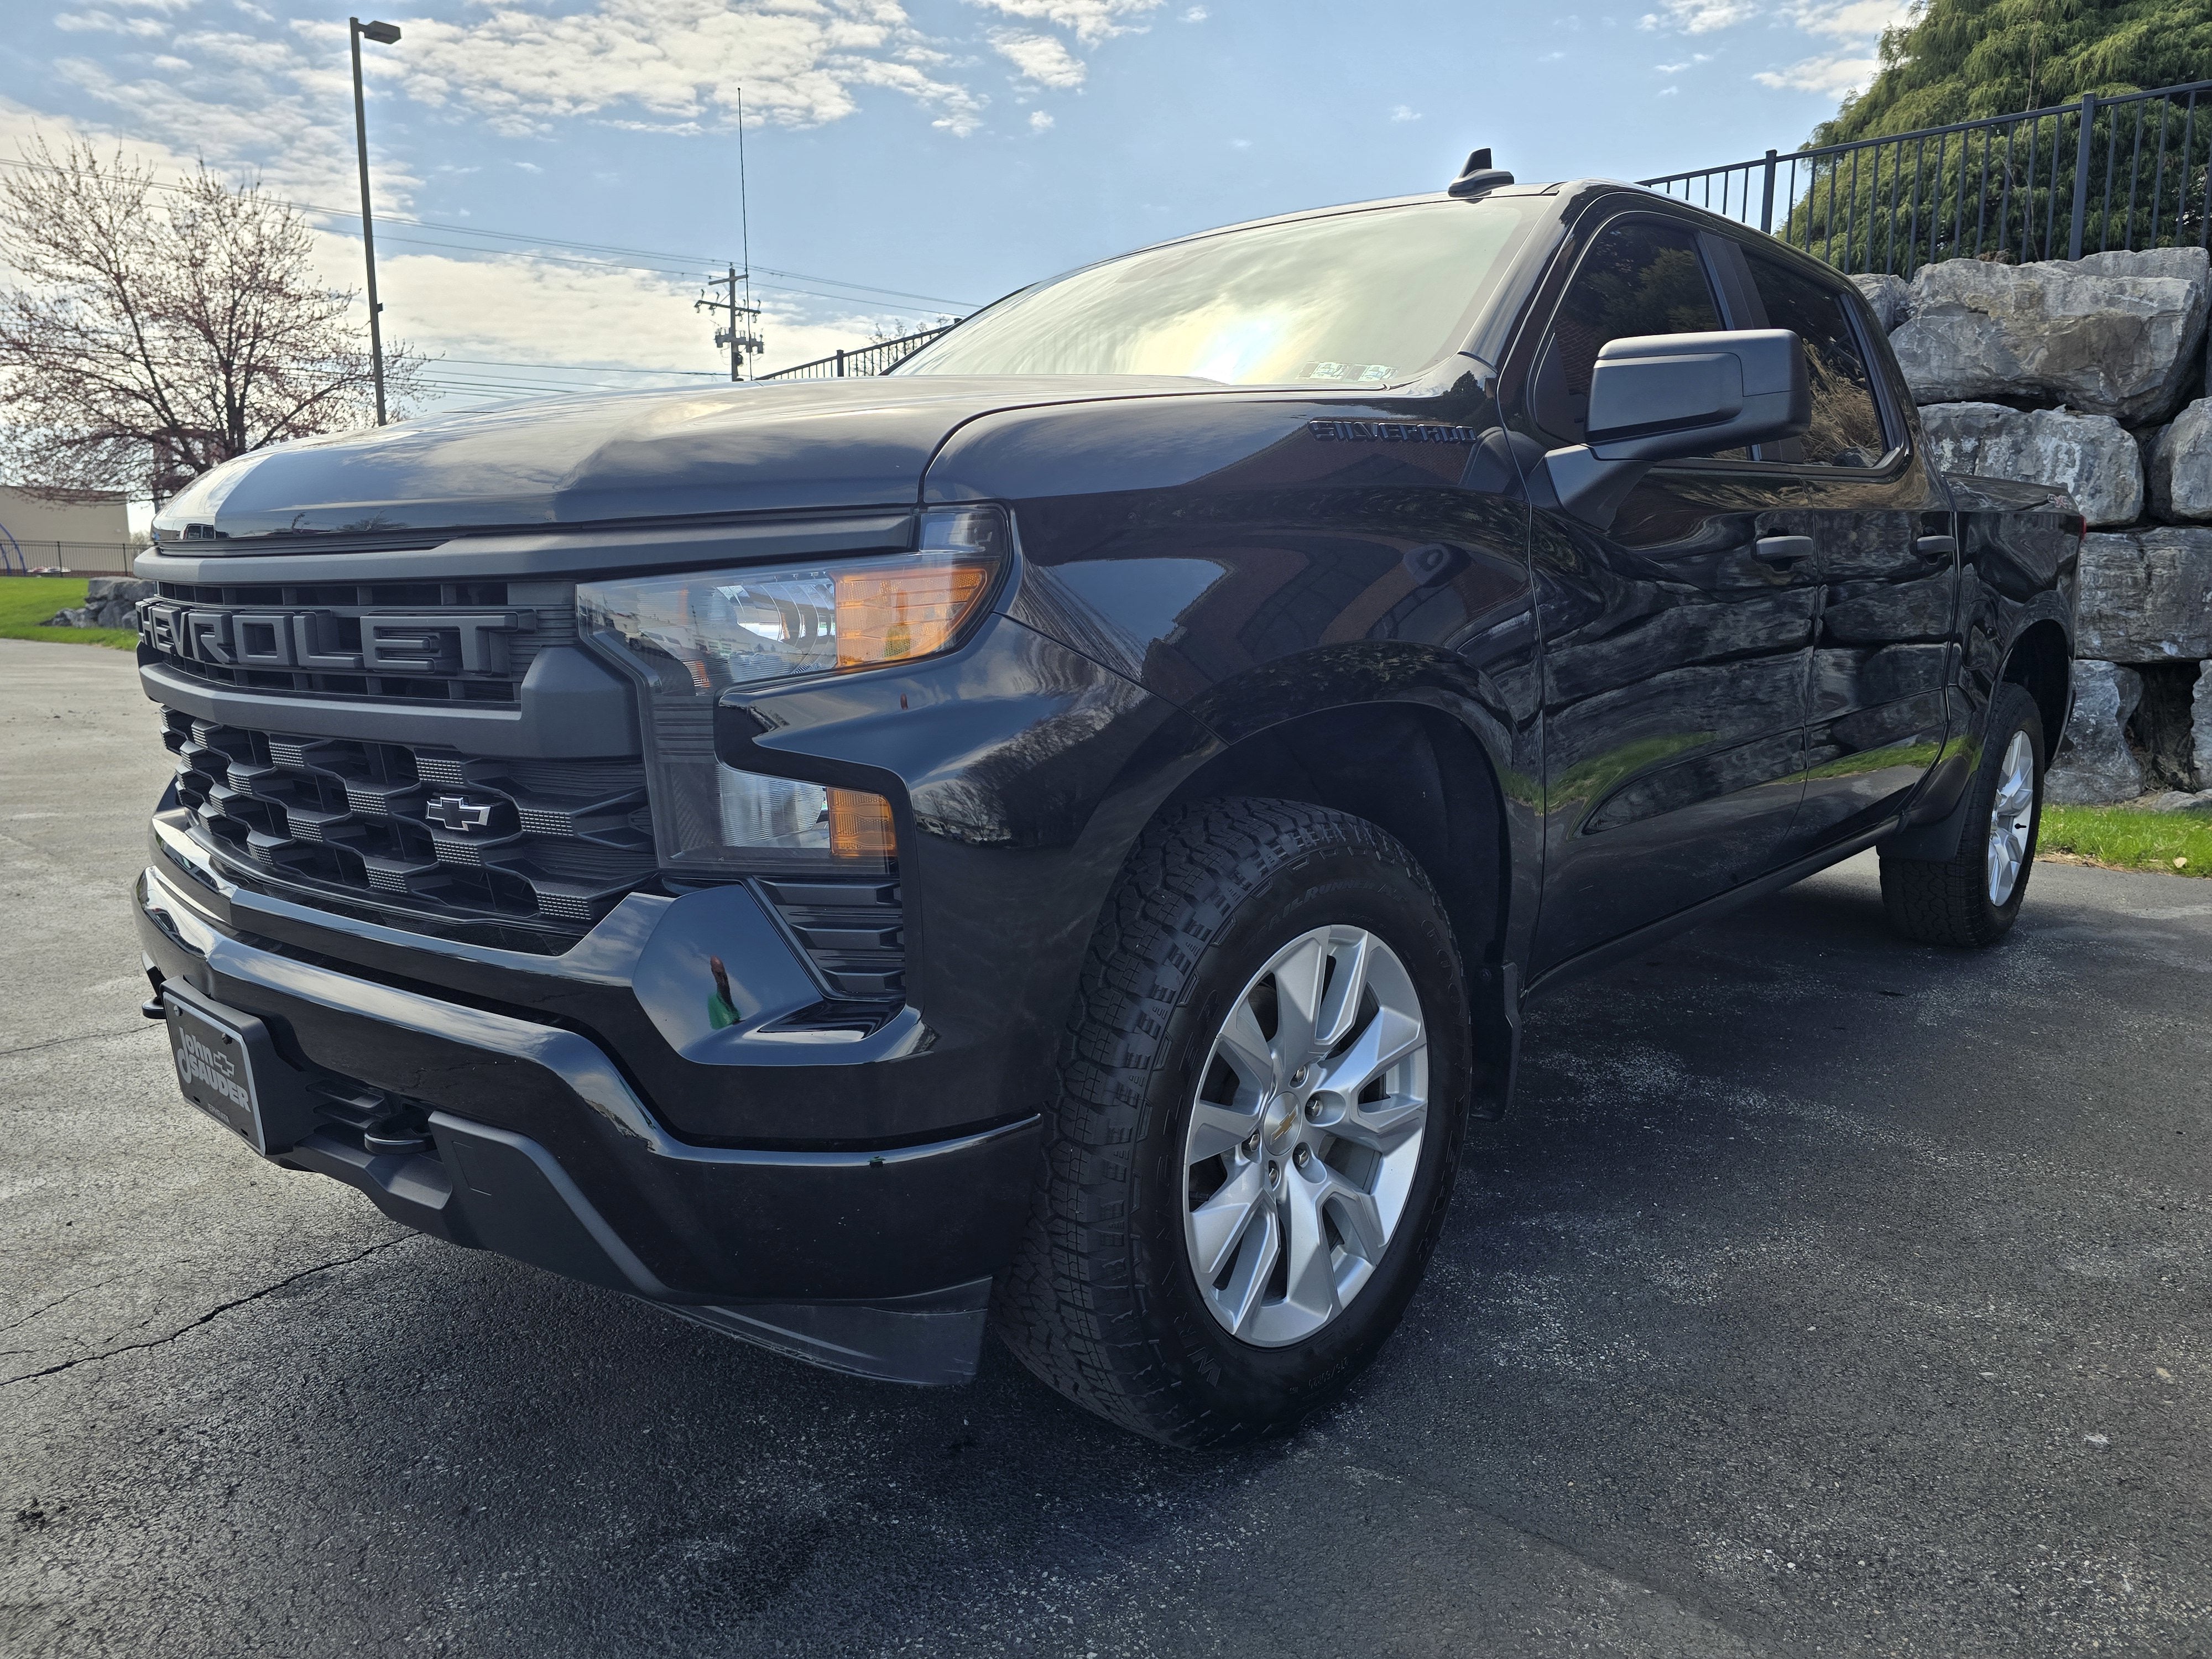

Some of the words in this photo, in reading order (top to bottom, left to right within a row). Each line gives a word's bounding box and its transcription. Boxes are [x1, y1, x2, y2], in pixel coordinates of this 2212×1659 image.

[1307, 420, 1478, 444] SILVERADO
[178, 1026, 214, 1084] John
[189, 1054, 251, 1113] SAUDER
